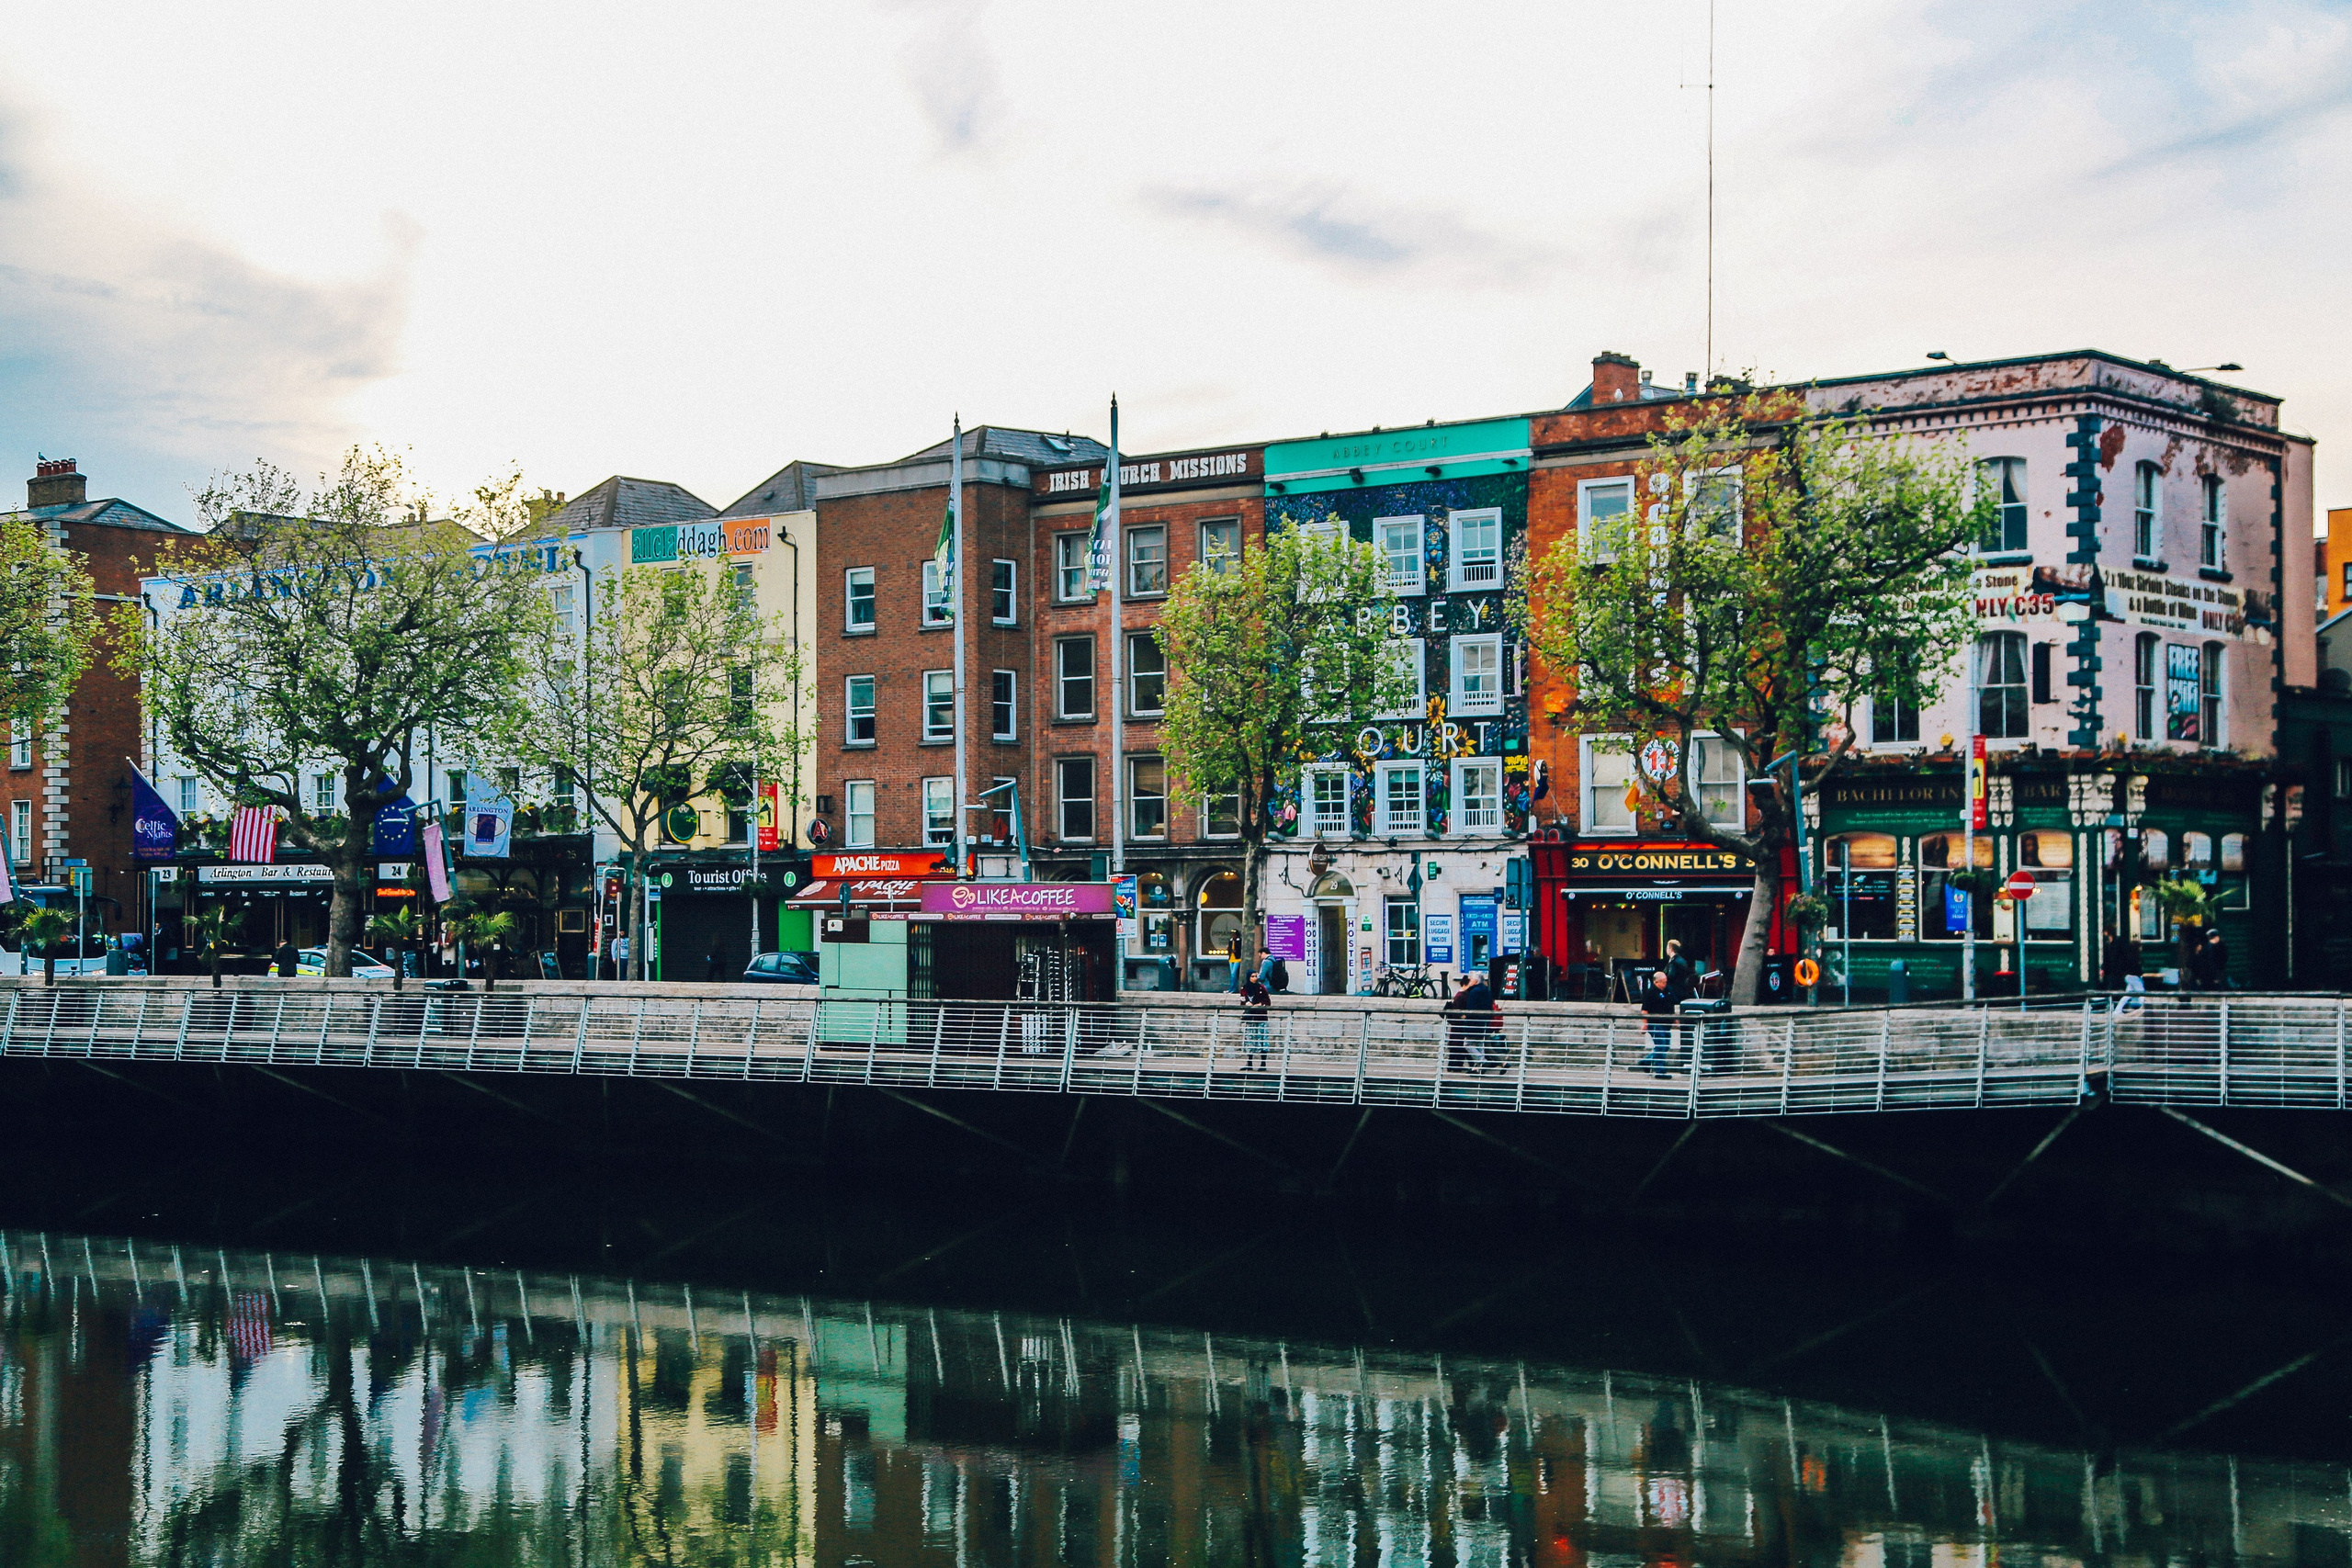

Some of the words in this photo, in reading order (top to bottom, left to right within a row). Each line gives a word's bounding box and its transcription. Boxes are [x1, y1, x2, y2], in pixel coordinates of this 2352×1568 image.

[1333, 444, 1382, 459] ABBEY
[1392, 436, 1448, 453] COURT
[1049, 469, 1090, 492] IRISH
[1101, 462, 1161, 486] URCH
[1170, 453, 1247, 479] MISSIONS
[632, 525, 770, 560] allcladdagh.com
[1985, 575, 2018, 588] Stone
[1976, 596, 2009, 618] NLY
[2169, 645, 2199, 680] FREE
[1327, 722, 1491, 759] OURT
[2024, 784, 2061, 798] BAR
[135, 818, 166, 834] Celtic
[832, 856, 880, 875] APACHE
[880, 860, 900, 871] PIZZA
[1571, 857, 1589, 868] 30
[1598, 854, 1736, 870] O'CONNELL'S
[162, 869, 172, 879] 23
[210, 867, 253, 880] Arlington
[262, 866, 277, 877] Bar
[283, 867, 290, 876] &
[391, 866, 401, 876] 24
[851, 881, 918, 892] APACHE
